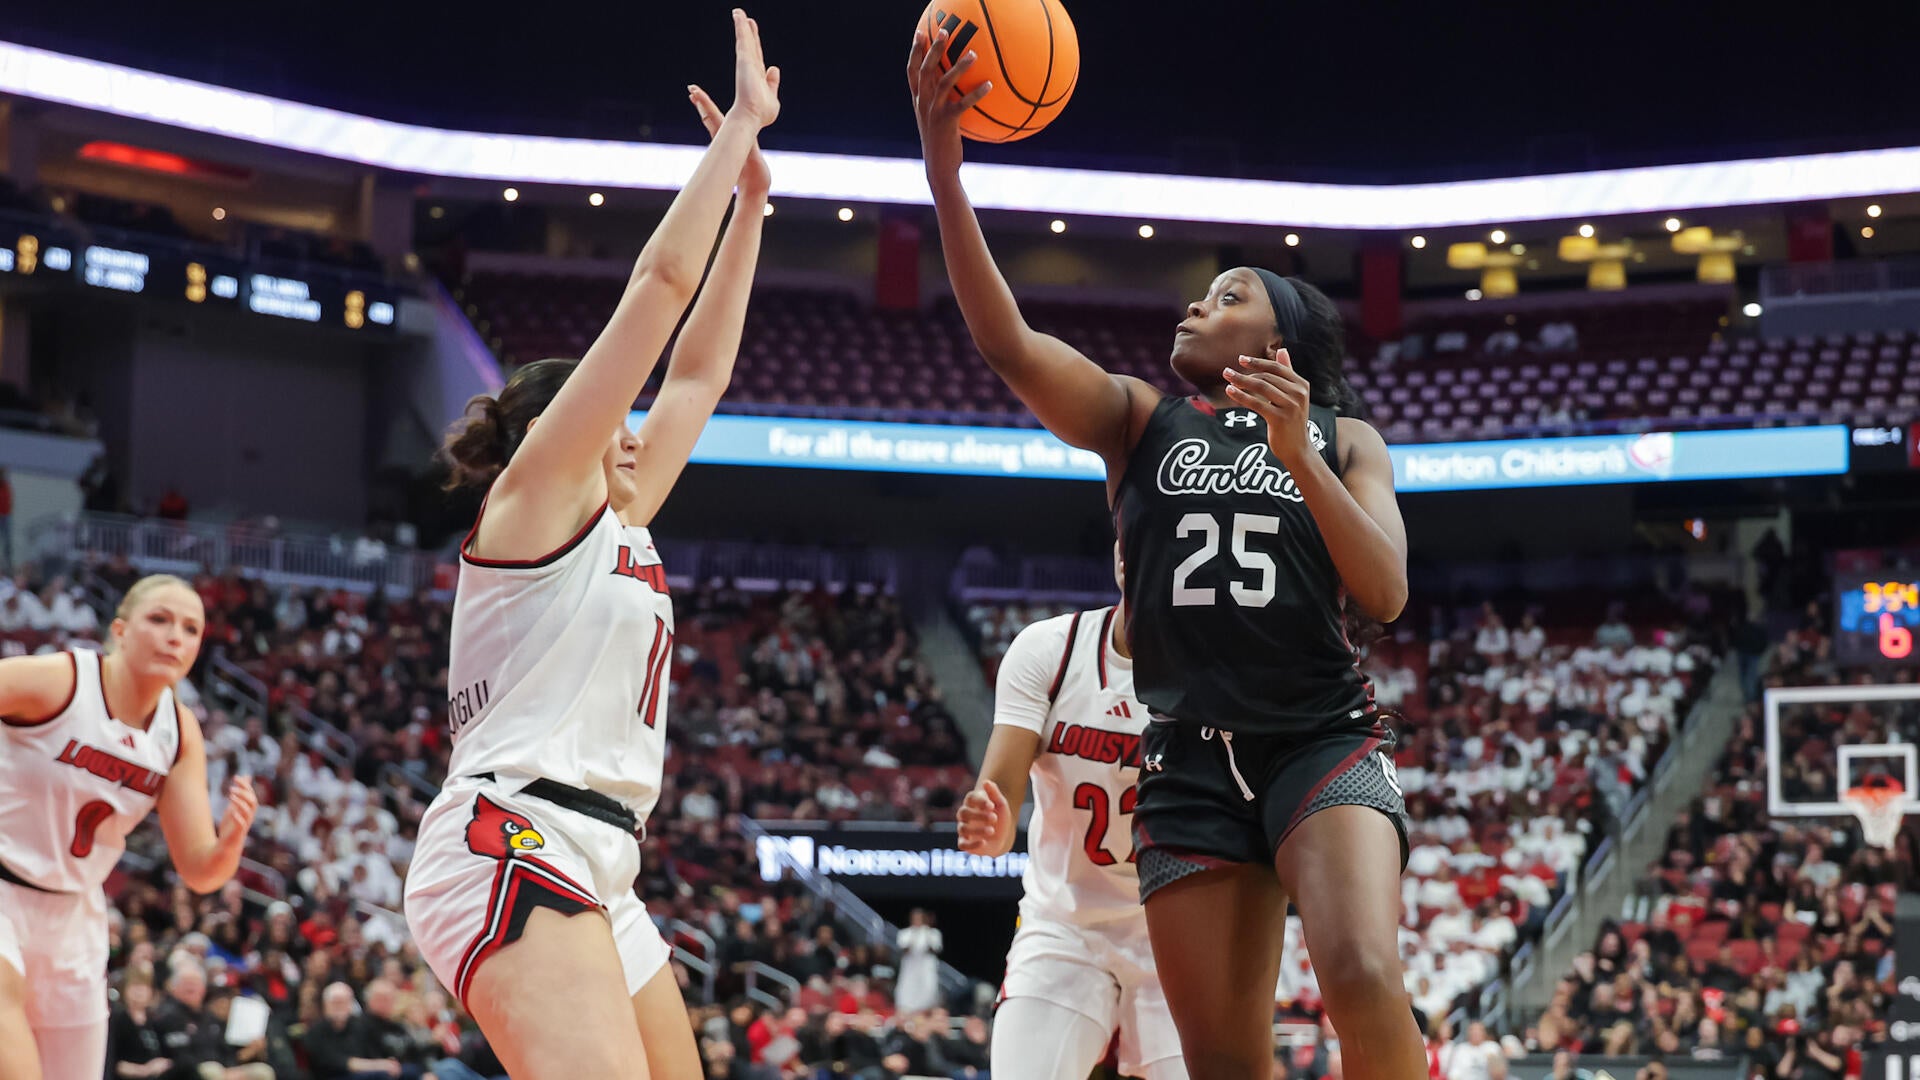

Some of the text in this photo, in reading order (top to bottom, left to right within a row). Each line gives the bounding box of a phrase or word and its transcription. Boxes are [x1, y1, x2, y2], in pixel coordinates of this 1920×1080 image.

[768, 427, 812, 456] For
[814, 428, 848, 458] all
[849, 430, 893, 461] the
[895, 440, 949, 463] care
[950, 435, 1022, 473] along
[1022, 438, 1066, 467] the
[1404, 453, 1497, 482] Norton
[1172, 513, 1281, 608] 25
[636, 610, 673, 730] 11
[817, 844, 931, 877] NORTON
